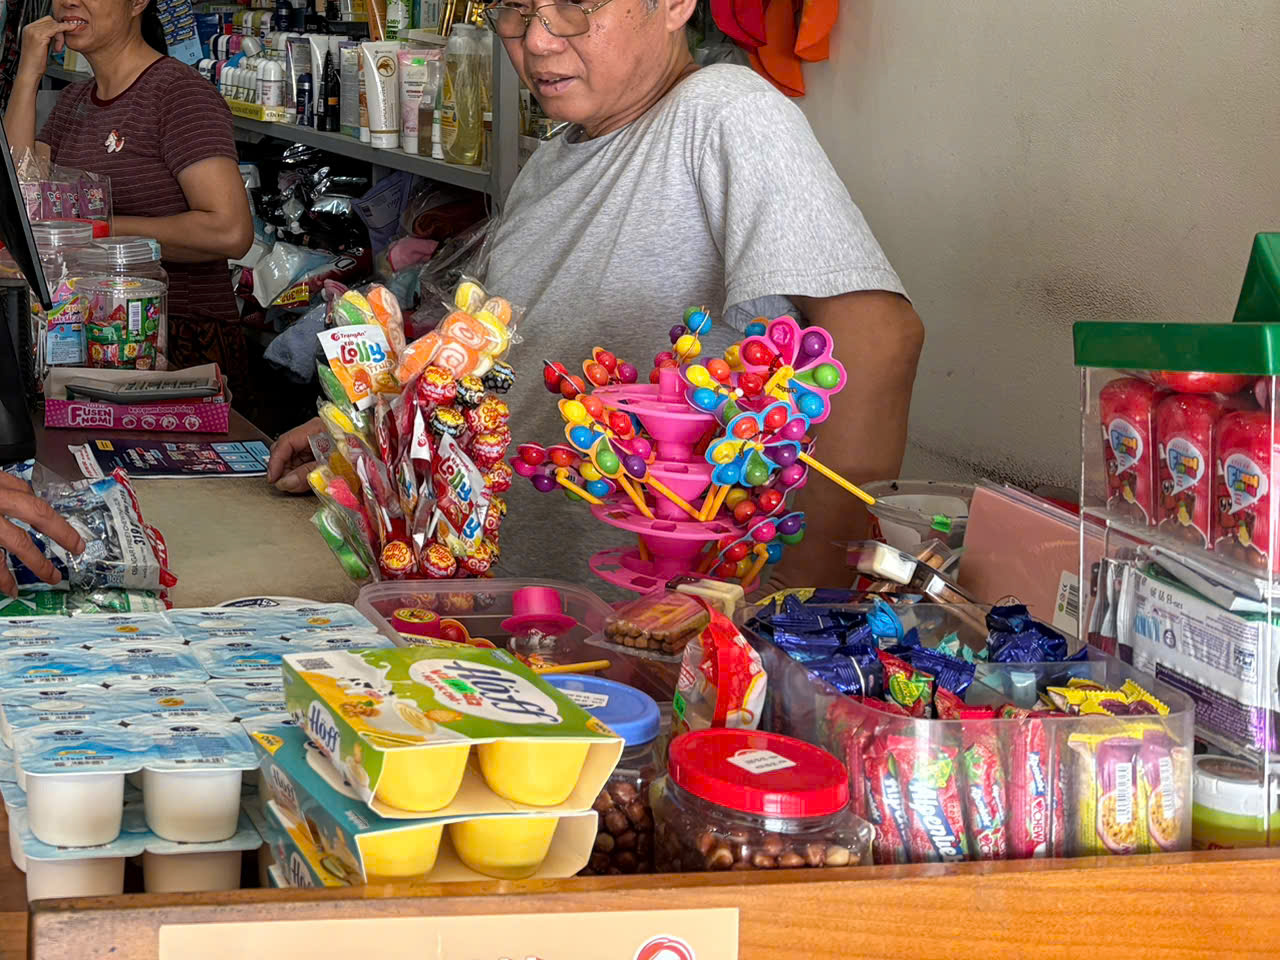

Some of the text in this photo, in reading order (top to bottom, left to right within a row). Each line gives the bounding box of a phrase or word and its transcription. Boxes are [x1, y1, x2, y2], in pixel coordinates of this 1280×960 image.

[340, 341, 386, 365] Lolly
[438, 460, 472, 503] Lolly
[442, 659, 563, 724] Höff
[310, 705, 339, 753] Höff
